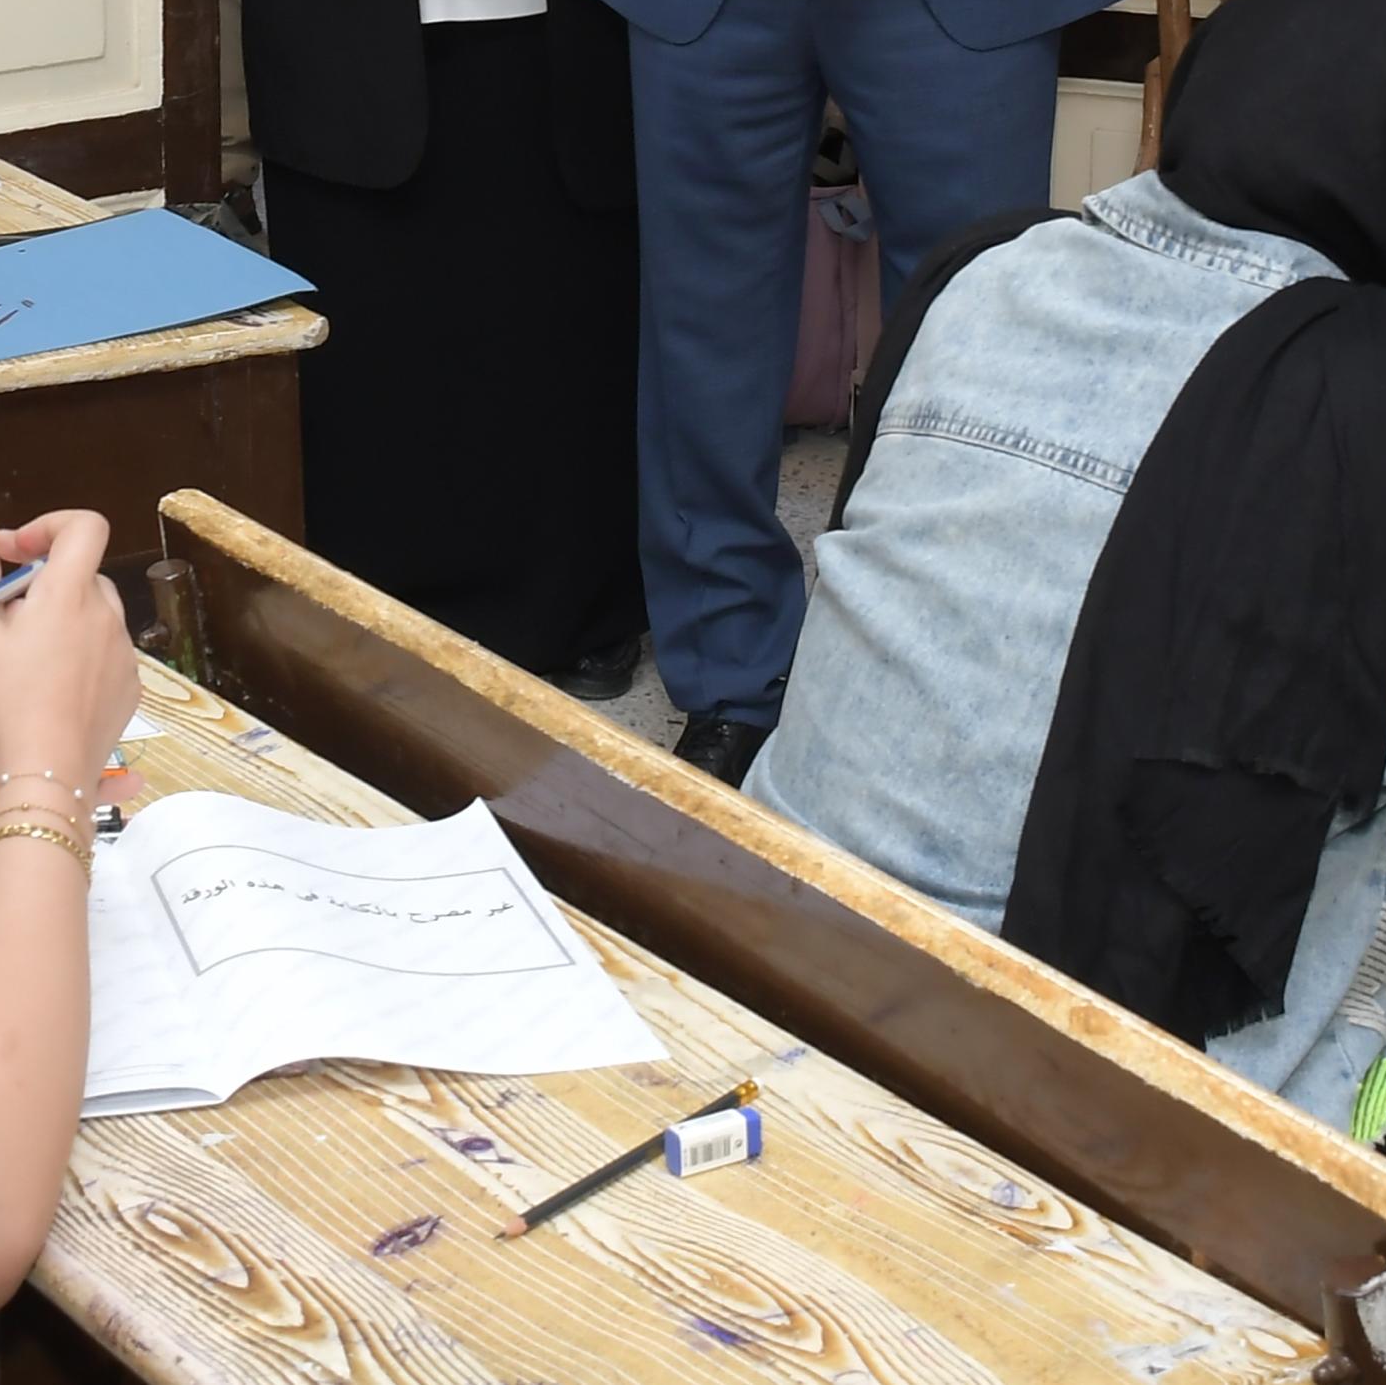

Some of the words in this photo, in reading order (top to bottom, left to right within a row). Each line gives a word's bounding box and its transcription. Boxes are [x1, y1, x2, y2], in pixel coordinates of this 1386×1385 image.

[181, 878, 237, 906] الورقة
[245, 877, 285, 892] هذه
[407, 907, 473, 924] مصرح
[485, 901, 515, 918] غير
